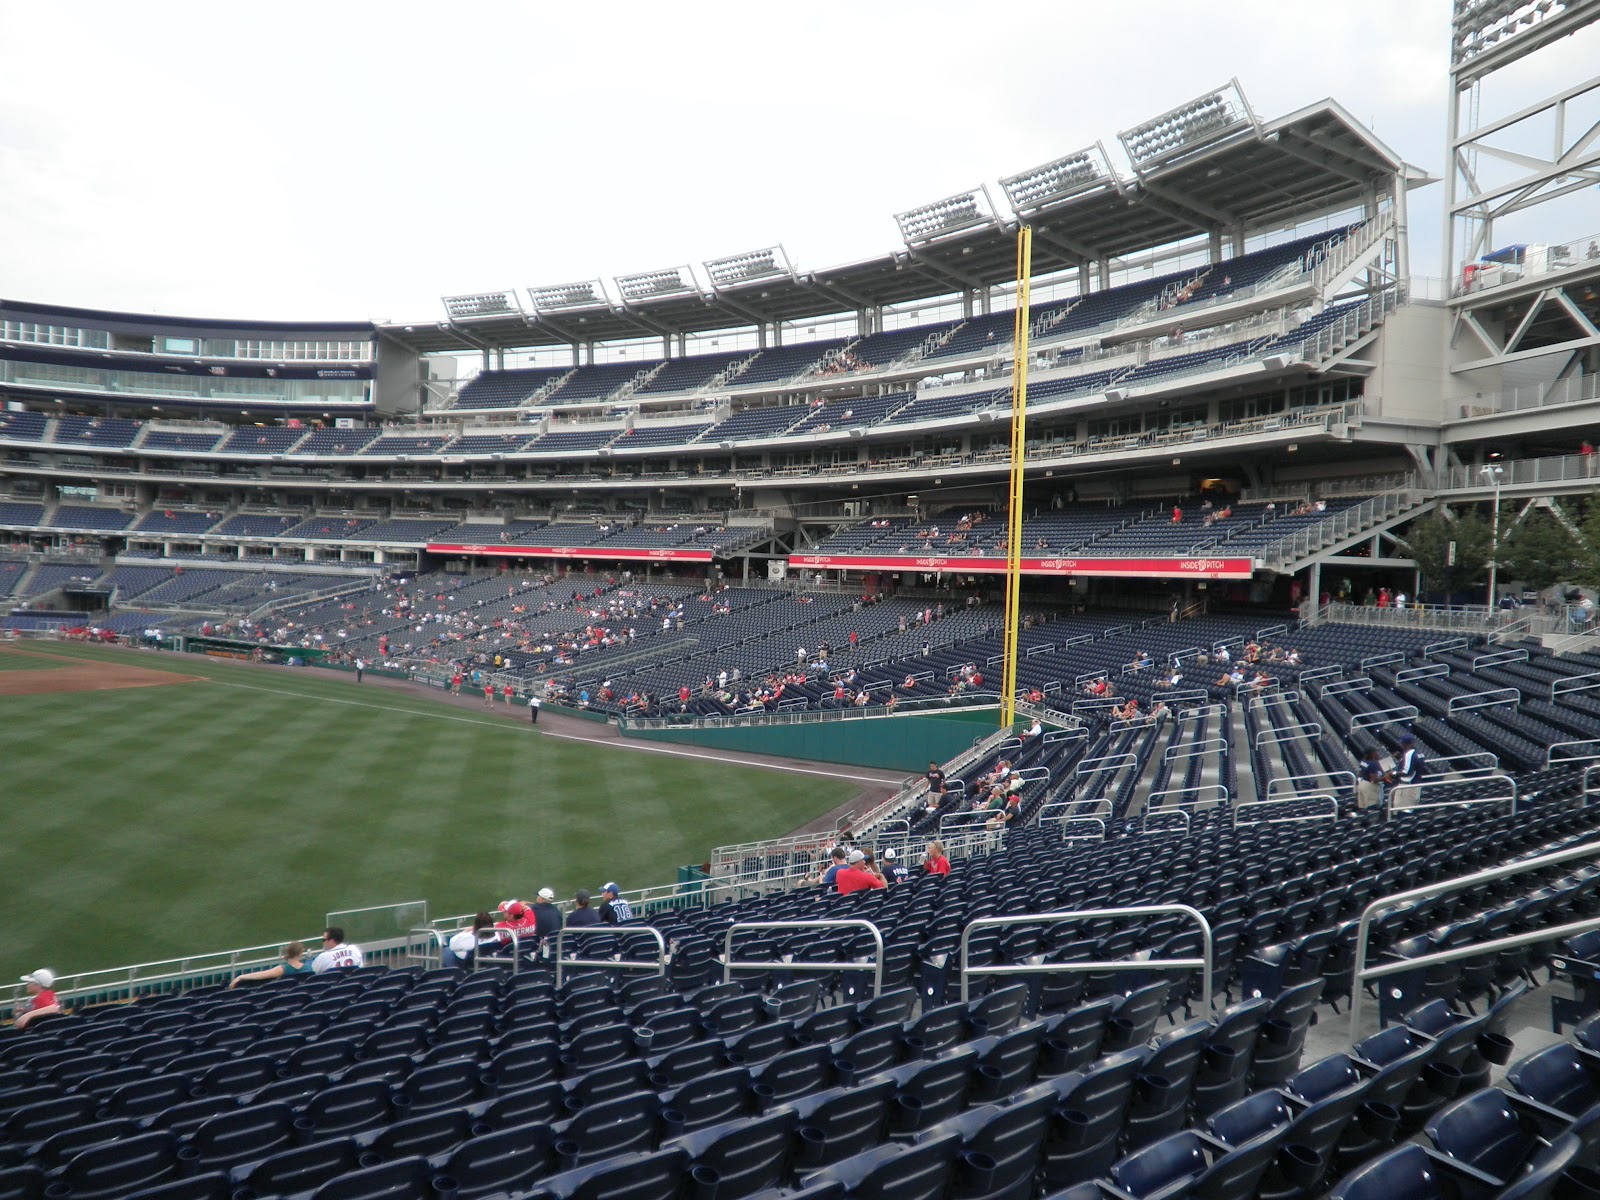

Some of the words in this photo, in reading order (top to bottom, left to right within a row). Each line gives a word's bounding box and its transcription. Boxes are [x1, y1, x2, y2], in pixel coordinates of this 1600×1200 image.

[1040, 560, 1055, 568] INSIDE
[1062, 560, 1077, 568] PITCH
[1180, 561, 1198, 569] INSIDE
[1206, 560, 1225, 569] PITCH
[613, 904, 633, 923] 16
[332, 950, 352, 961] JONES
